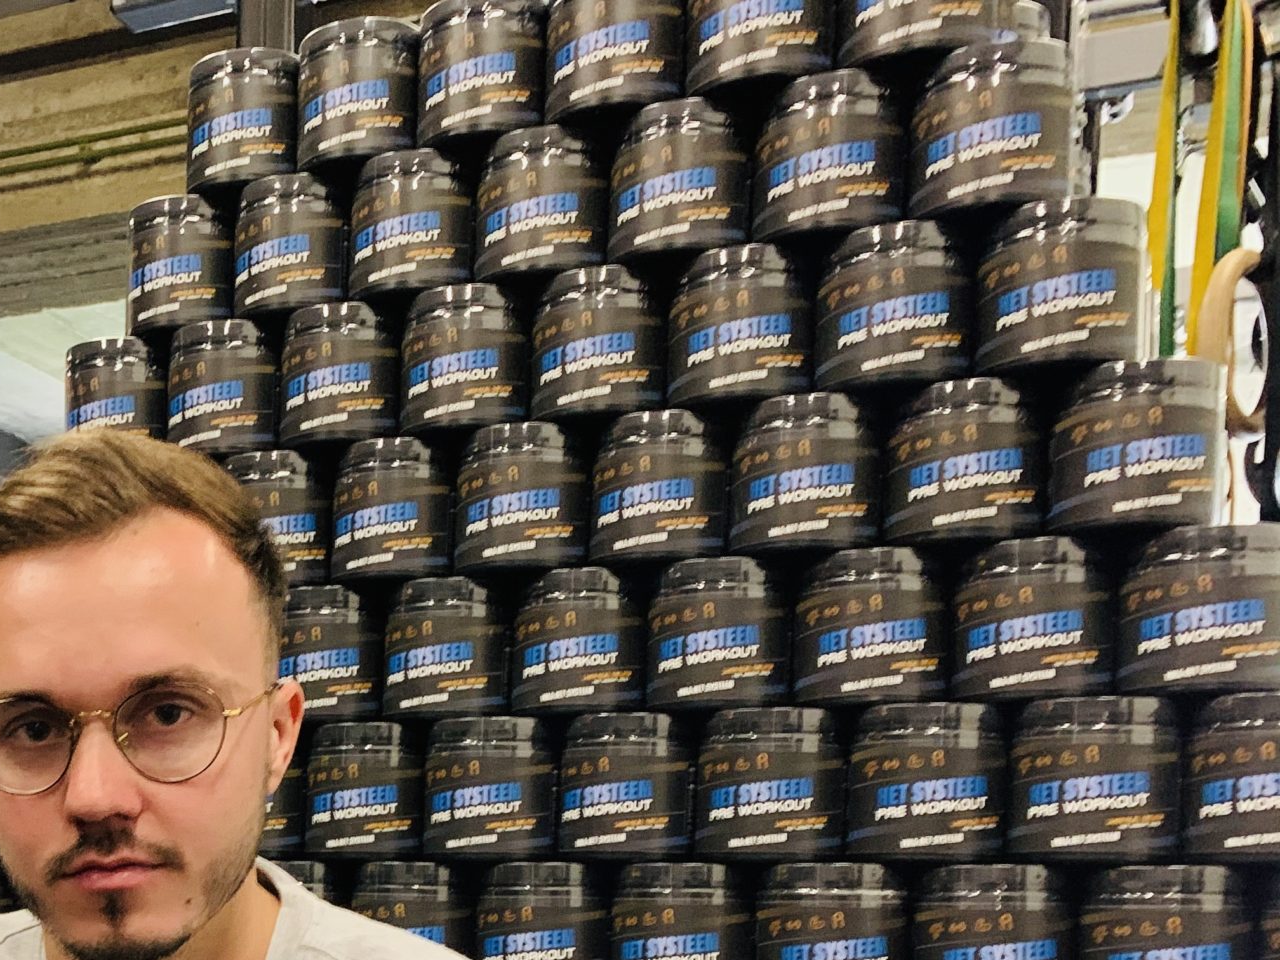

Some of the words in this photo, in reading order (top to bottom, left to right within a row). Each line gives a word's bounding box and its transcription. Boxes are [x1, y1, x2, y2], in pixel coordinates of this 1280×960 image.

[578, 40, 649, 69] WORKOUT
[325, 98, 388, 120] WORKOUT
[958, 133, 1041, 163] WORKOUT
[798, 161, 875, 188] WORKOUT
[643, 187, 716, 212] WORKOUT
[1032, 291, 1115, 317] WORKOUT
[871, 313, 949, 337] WORKOUT
[432, 367, 498, 388] WORKOUT
[185, 397, 243, 419] WORKOUT
[1125, 456, 1206, 477] WORKOUT
[943, 469, 1022, 492] WORKOUT
[778, 484, 854, 505] WORKOUT
[491, 507, 559, 527] WORKOUT
[999, 631, 1083, 654] WORKOUT
[1175, 620, 1265, 645] WORKOUT
[686, 645, 759, 665] WORKOUT
[851, 639, 926, 659] WORKOUT
[549, 652, 618, 671] WORKOUT
[453, 801, 522, 819] WORKOUT
[738, 798, 813, 816] WORKOUT
[911, 797, 987, 815] WORKOUT
[1063, 793, 1150, 813] WORKOUT
